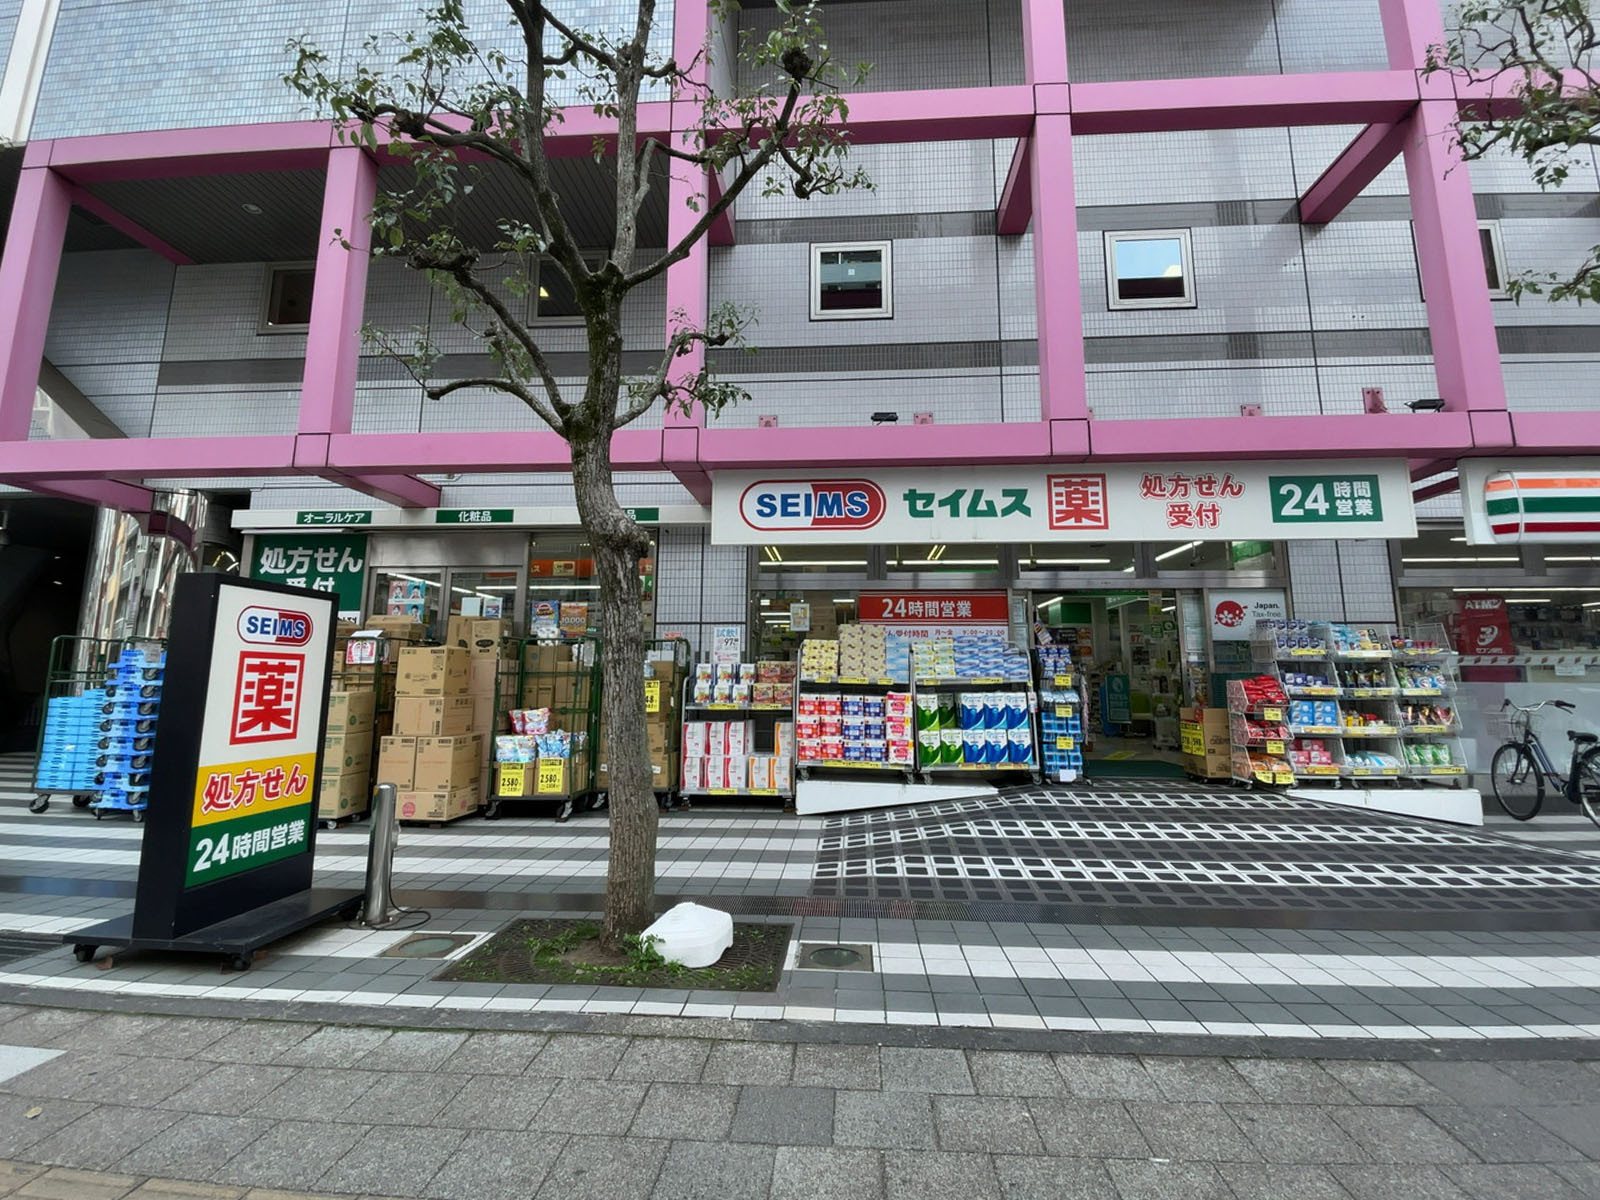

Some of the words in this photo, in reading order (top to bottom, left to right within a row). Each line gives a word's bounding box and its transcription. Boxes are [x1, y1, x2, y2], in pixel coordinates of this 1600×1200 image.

[1140, 473, 1245, 499] 処方せん
[1279, 483, 1330, 517] 24
[1333, 481, 1372, 499] 時間
[755, 491, 870, 519] SEIMS
[902, 488, 1032, 518] セイムス
[1052, 478, 1104, 524] 薬
[1335, 499, 1373, 516] 営業
[303, 512, 365, 524] オーラルケア
[458, 511, 492, 522] 化粧品
[1166, 503, 1221, 530] 受付
[259, 547, 363, 574] 処方せん
[881, 598, 972, 618] 24時間営業
[246, 615, 306, 638] SEIMS
[238, 661, 298, 734] 薬
[202, 763, 308, 815] 処方せん
[192, 819, 306, 873] 24時間営業
